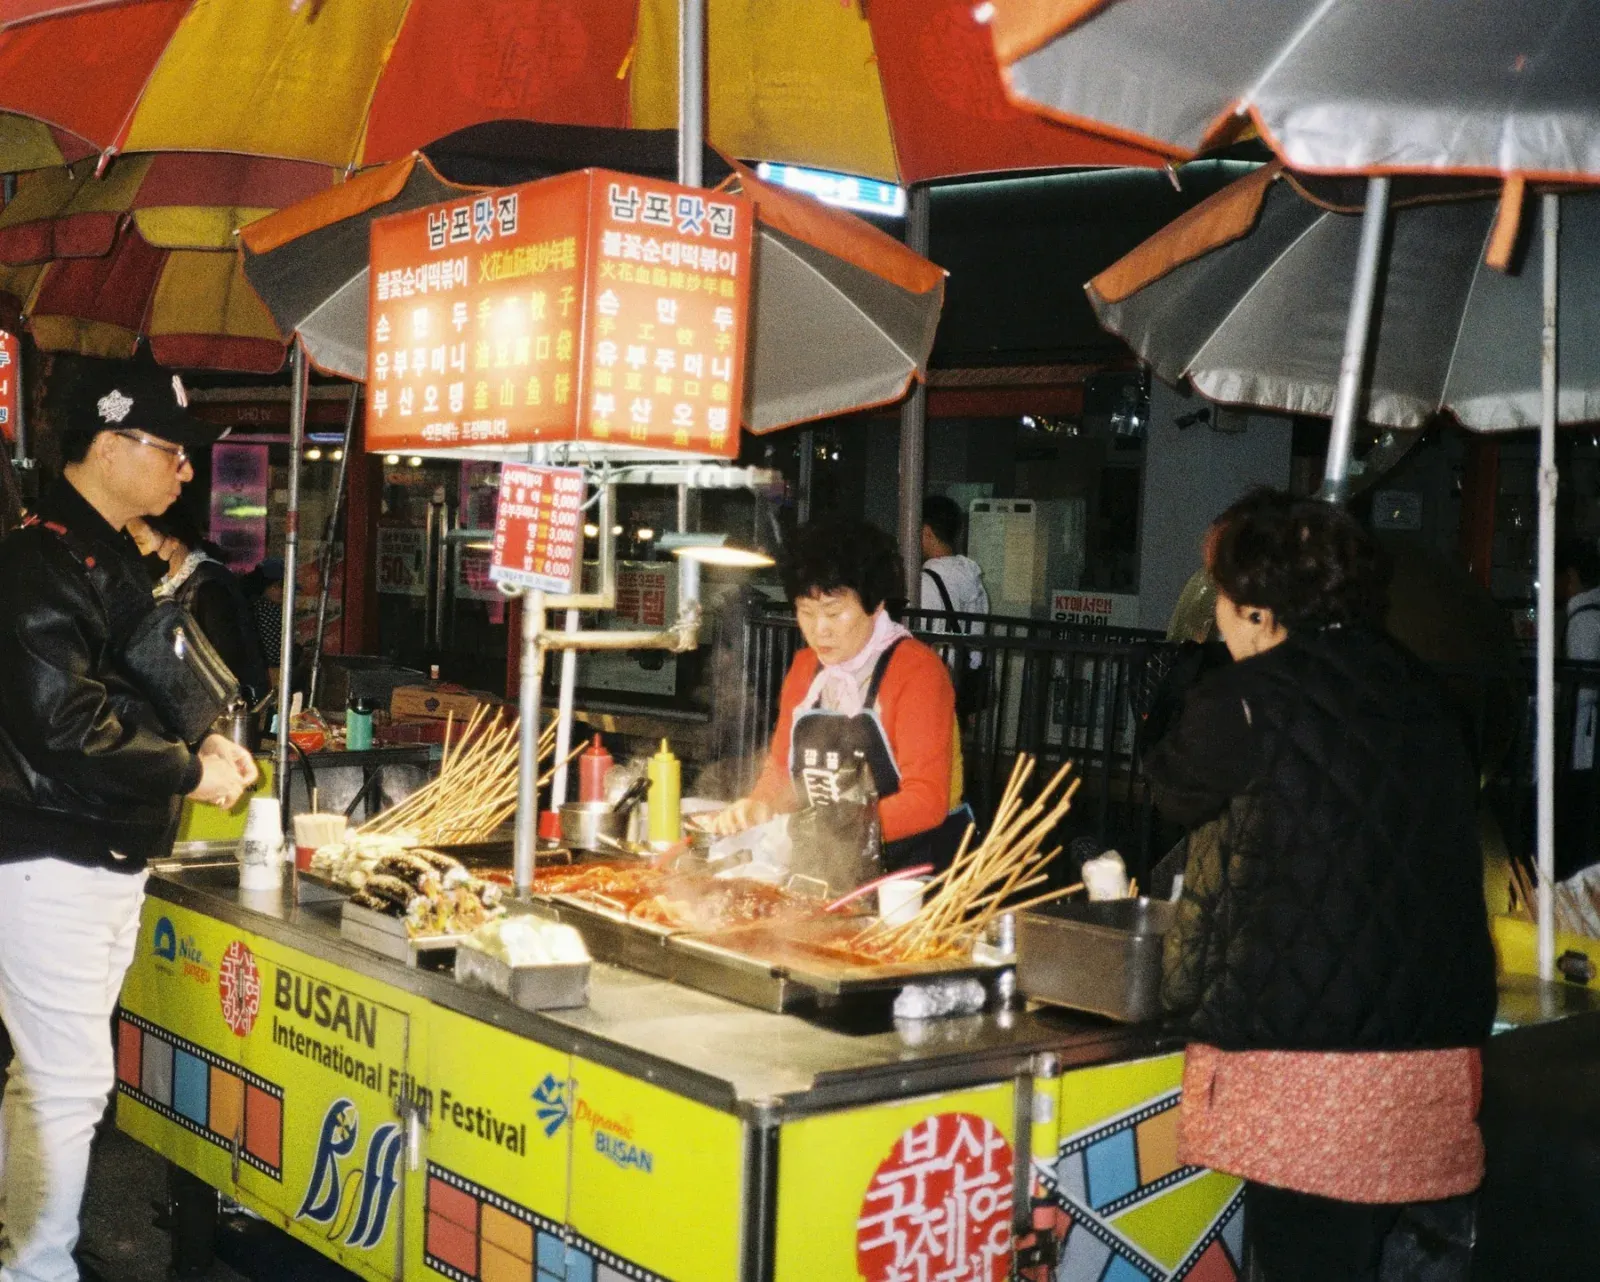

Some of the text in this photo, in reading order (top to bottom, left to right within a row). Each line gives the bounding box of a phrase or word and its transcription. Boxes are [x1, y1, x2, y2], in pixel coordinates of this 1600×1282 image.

[429, 194, 519, 250] 남포맛집
[608, 182, 736, 240] 남포맛집
[602, 230, 738, 277] 불꽃순대떡볶이
[377, 256, 468, 301] 불꽃순대떡볶이
[375, 340, 466, 381] 유부주머니
[595, 340, 731, 382] 유부주머니
[548, 527, 574, 543] 3,000
[550, 510, 576, 526] 5,000
[273, 967, 378, 1049] BUSAN
[272, 1016, 526, 1157] International Film Festival
[595, 1130, 653, 1173] BUSAN
